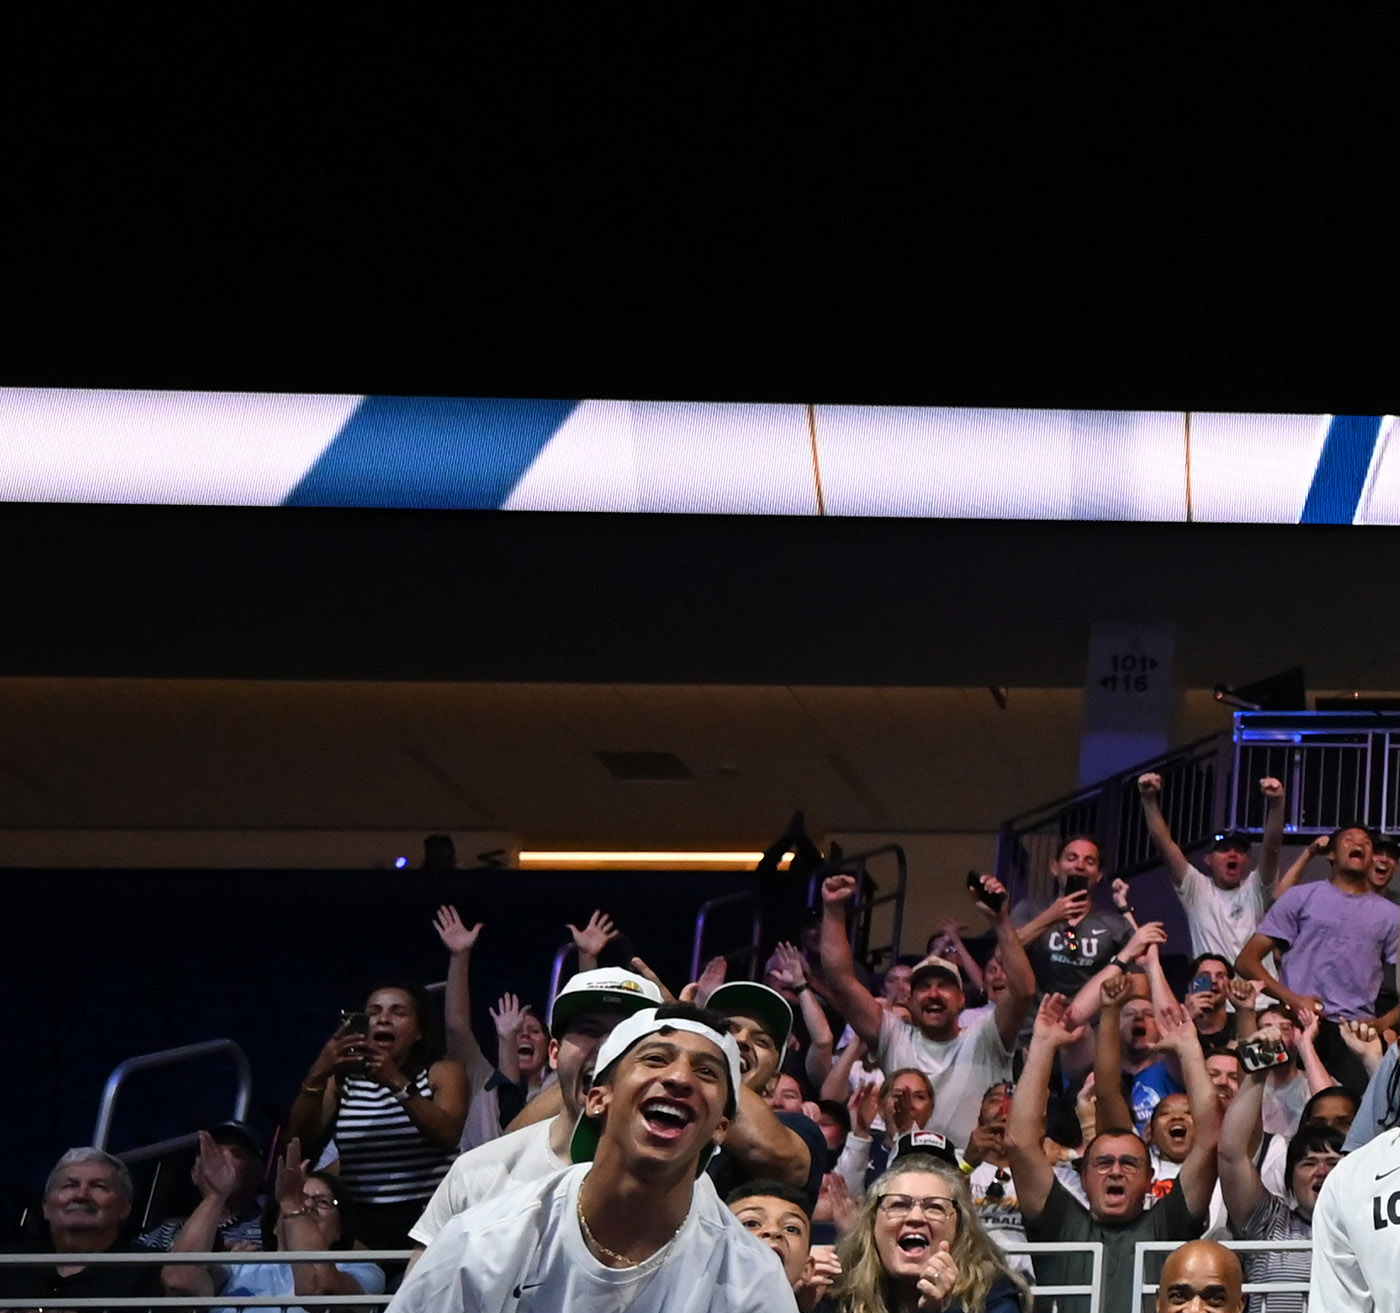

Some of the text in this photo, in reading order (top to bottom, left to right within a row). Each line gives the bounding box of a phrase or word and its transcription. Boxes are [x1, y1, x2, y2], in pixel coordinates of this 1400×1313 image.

[1112, 655, 1147, 673] 101
[1111, 675, 1149, 693] 116
[1049, 932, 1098, 957] CU
